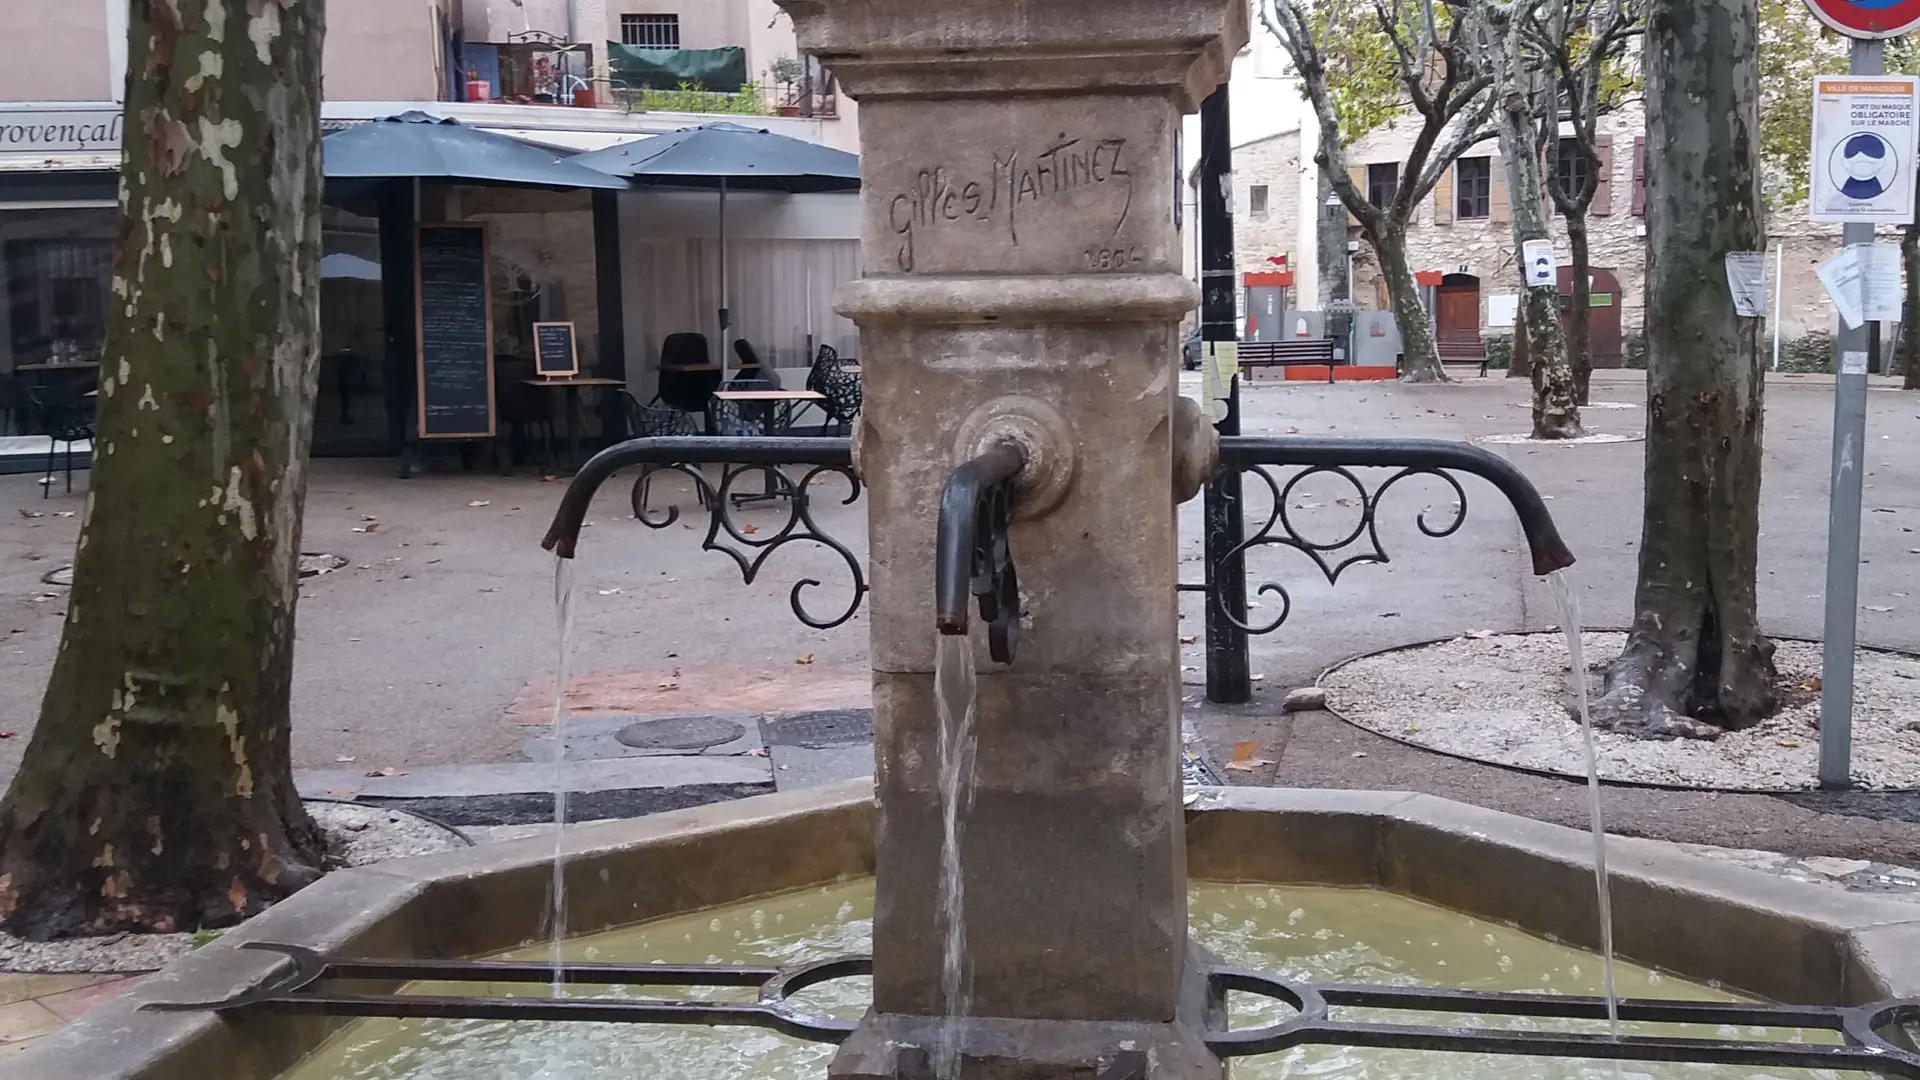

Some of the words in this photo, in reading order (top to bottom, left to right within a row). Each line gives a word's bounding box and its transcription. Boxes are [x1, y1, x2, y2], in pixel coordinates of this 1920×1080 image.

[1861, 85, 1906, 93] MANOSQUE
[1850, 111, 1912, 119] OBLIGATOIRE
[1878, 118, 1911, 126] MARCHÉ
[0, 113, 124, 151] rovençal
